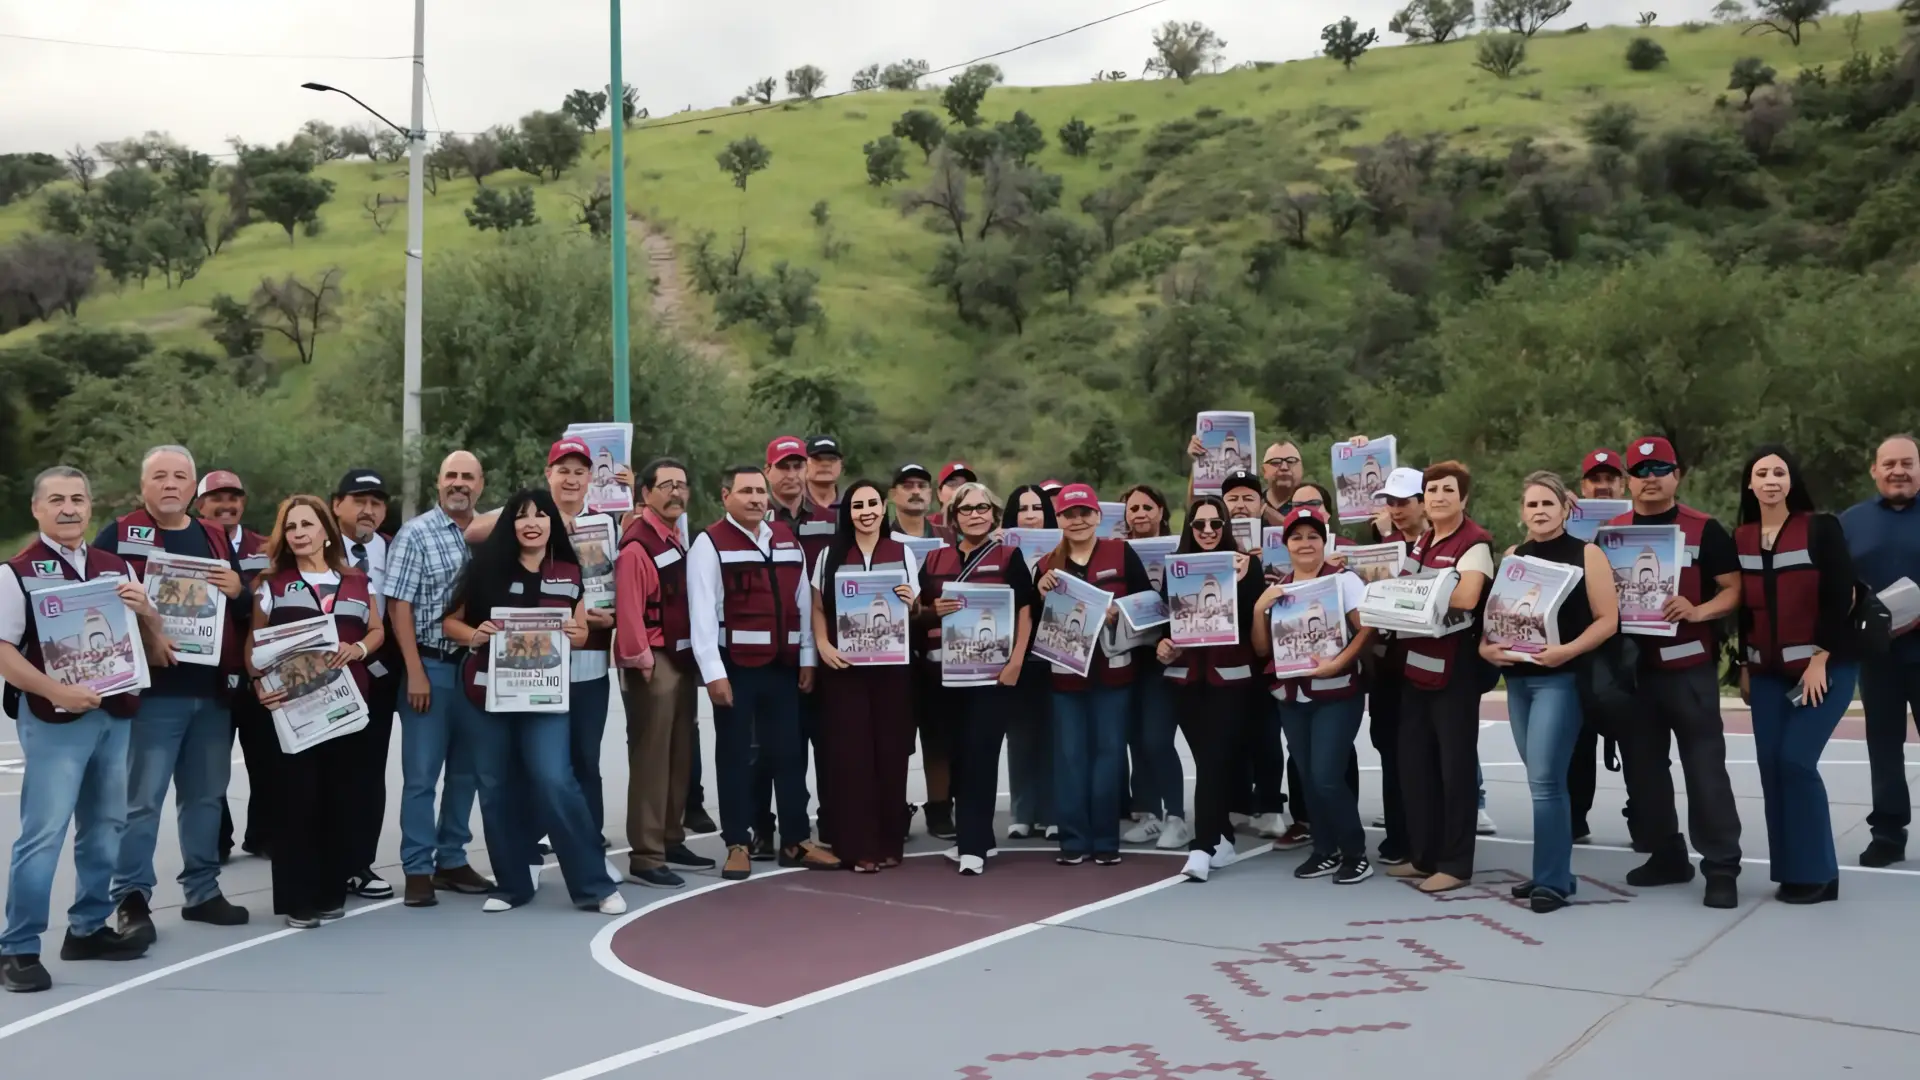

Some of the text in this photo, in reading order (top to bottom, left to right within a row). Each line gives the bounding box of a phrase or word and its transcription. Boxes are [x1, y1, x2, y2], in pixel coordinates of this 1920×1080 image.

[1416, 585, 1429, 596] NO
[198, 625, 213, 637] NO
[546, 675, 560, 687] NO
[334, 685, 350, 699] NO
